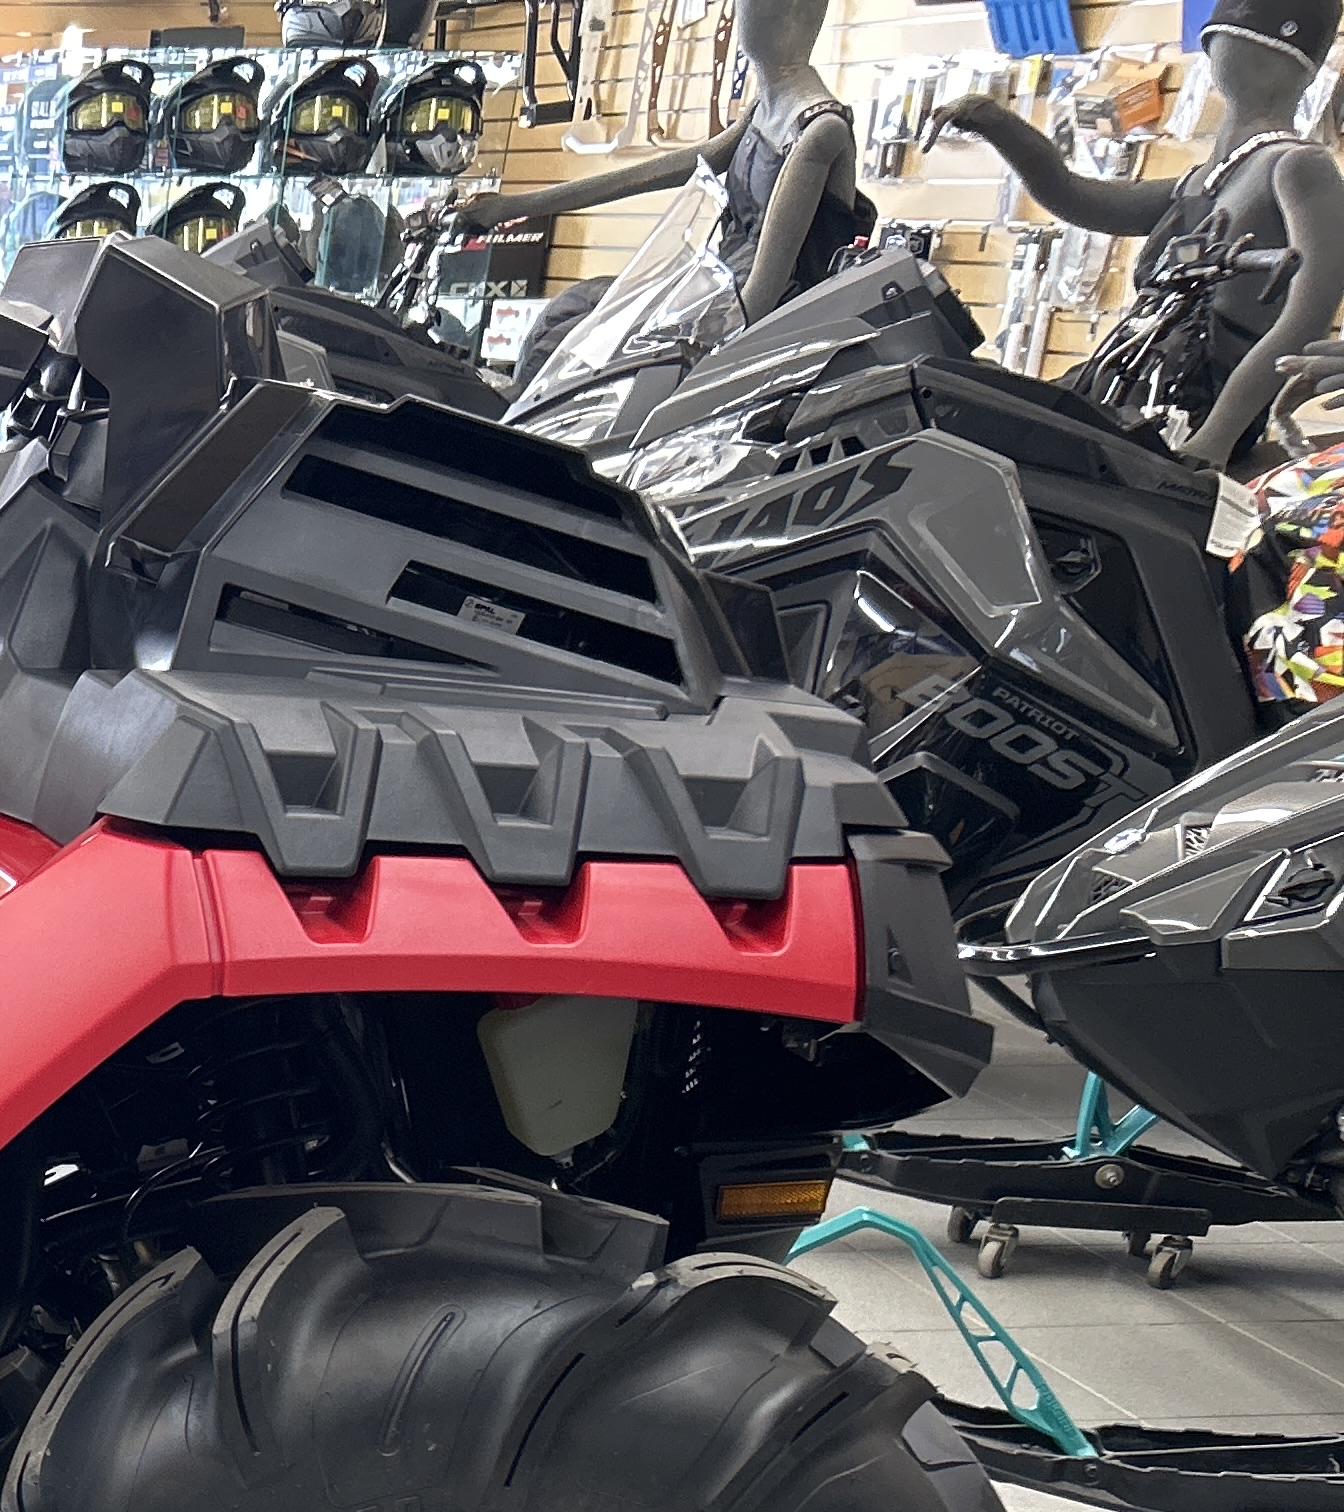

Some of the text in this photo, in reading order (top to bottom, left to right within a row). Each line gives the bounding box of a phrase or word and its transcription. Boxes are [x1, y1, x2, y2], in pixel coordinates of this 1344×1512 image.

[476, 232, 544, 244] FULMER
[896, 674, 1150, 807] BOOST
[992, 687, 1080, 741] PATRIOT
